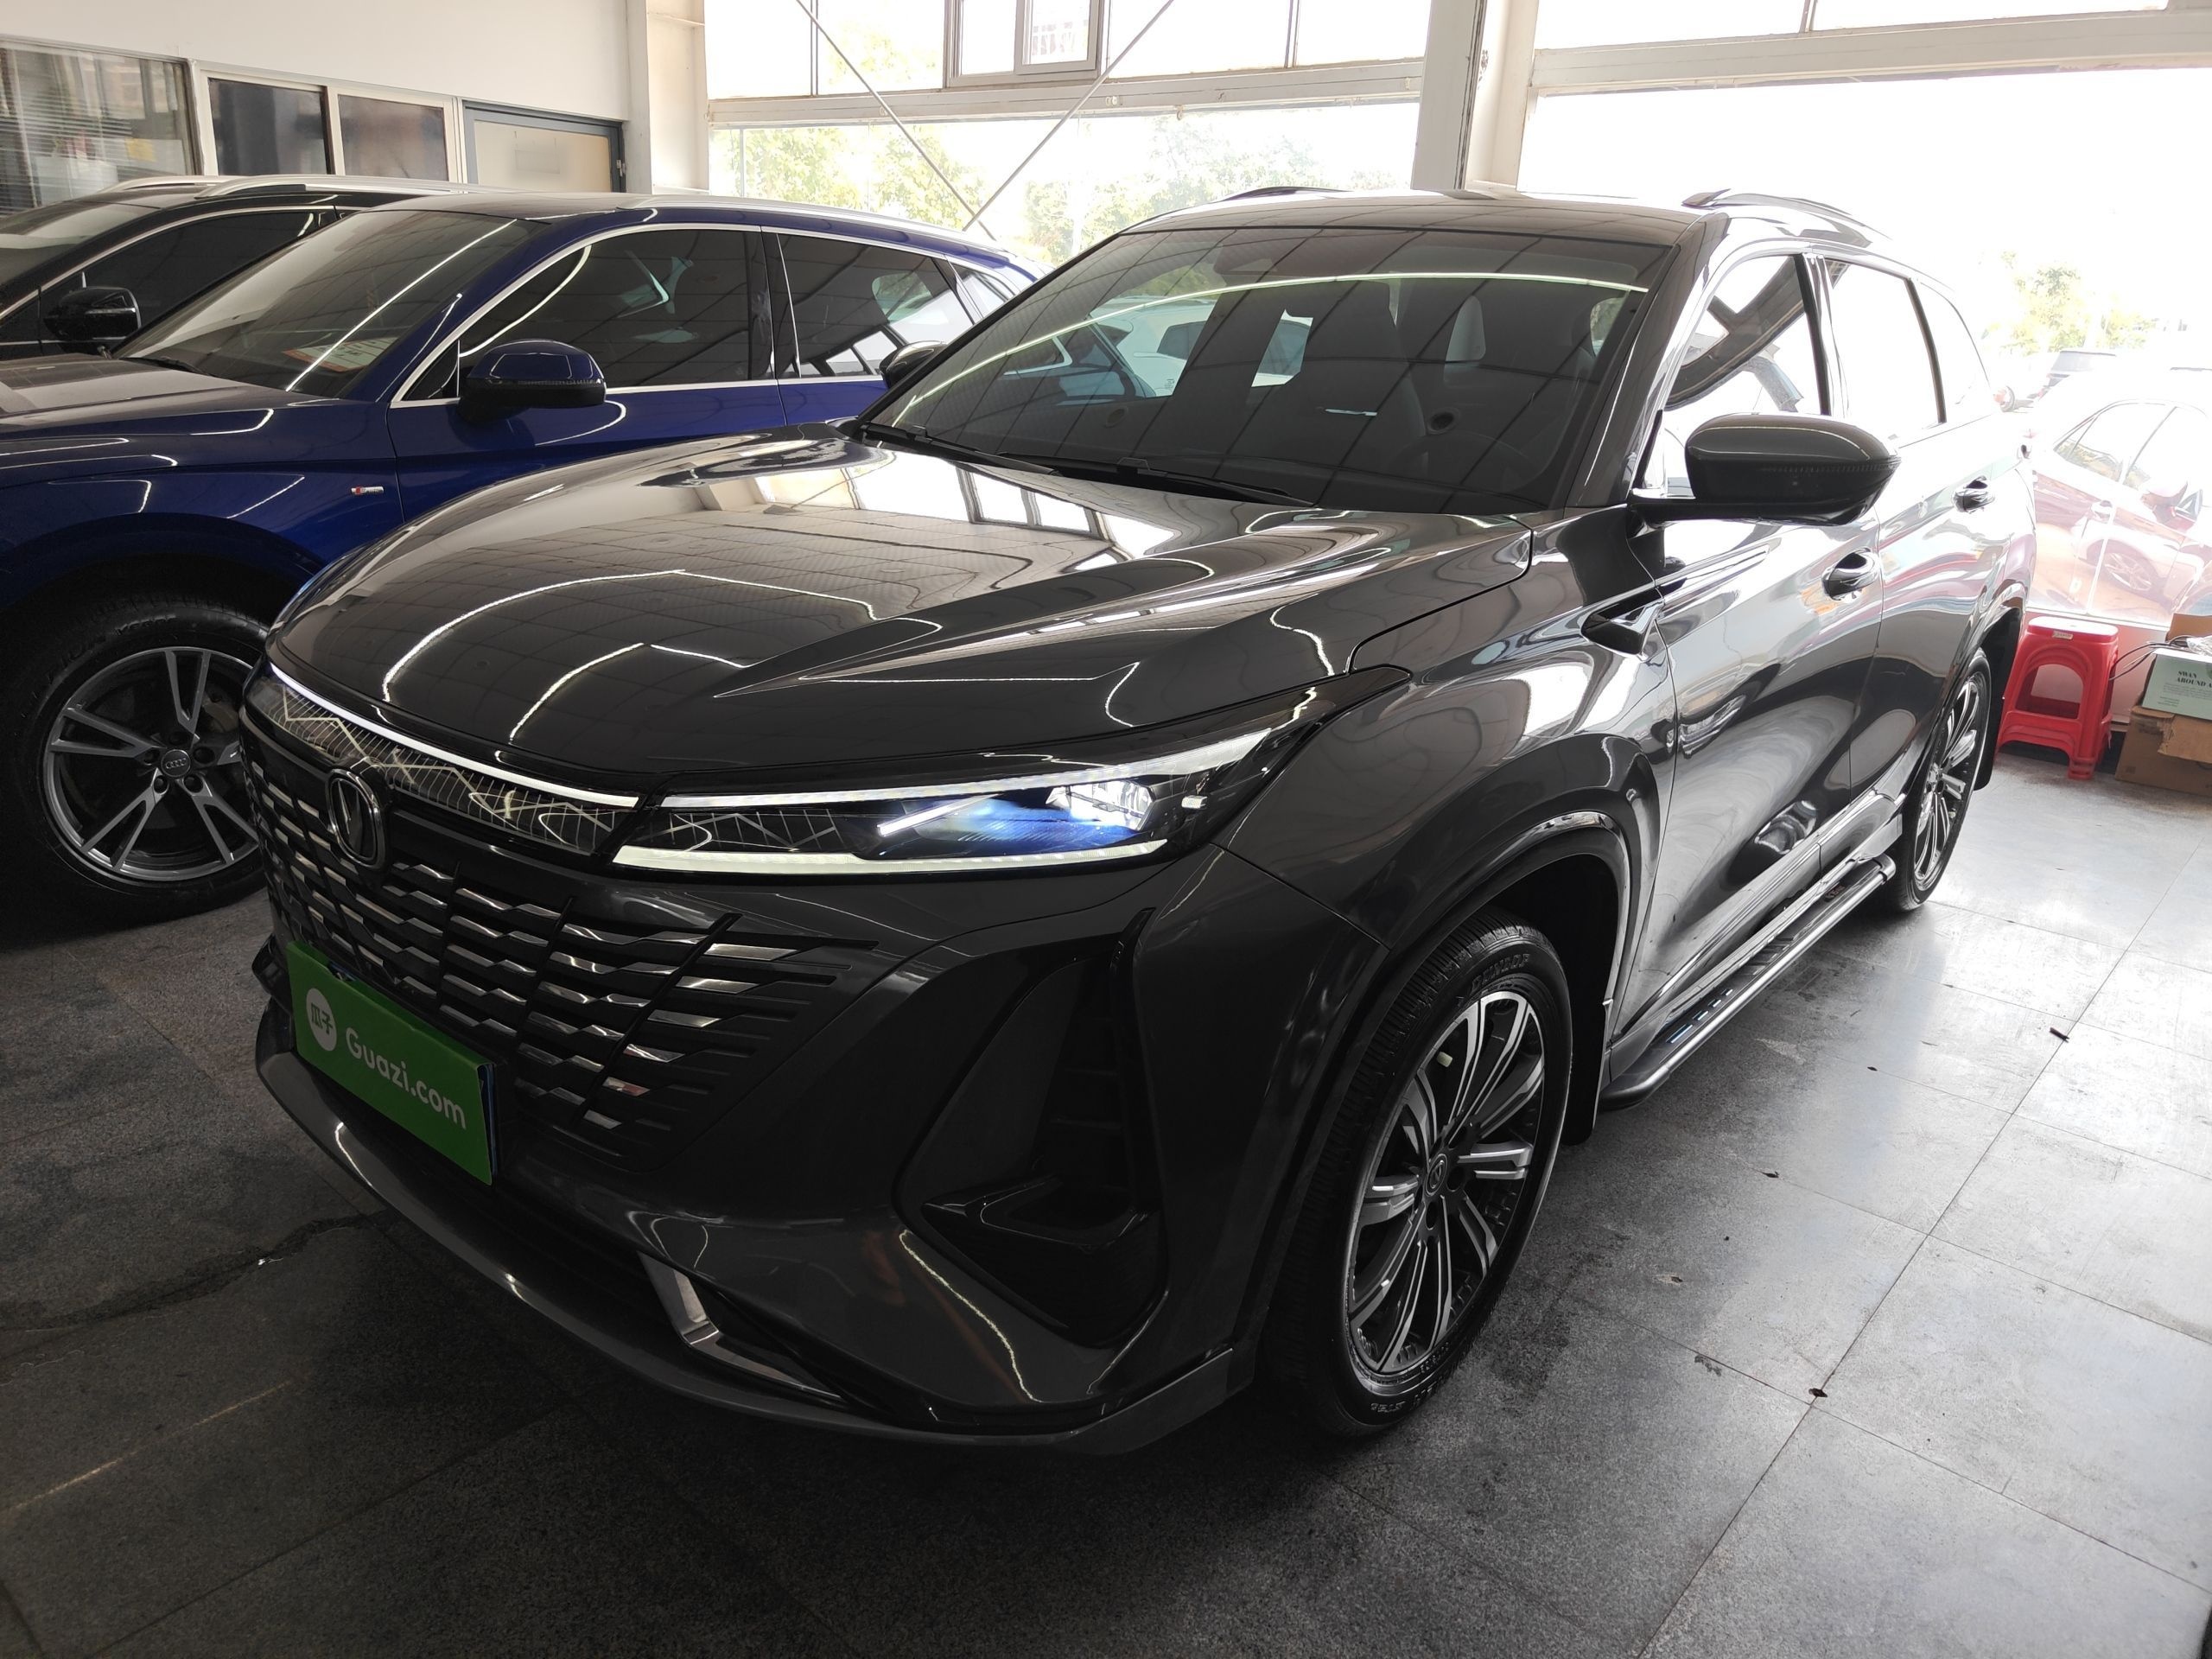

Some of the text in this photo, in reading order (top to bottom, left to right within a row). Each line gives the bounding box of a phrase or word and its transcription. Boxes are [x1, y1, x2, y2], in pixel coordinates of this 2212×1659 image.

[2176, 677, 2207, 687] AROUND
[309, 1001, 334, 1035] 瓜子
[346, 1027, 467, 1130] Guazi.com
